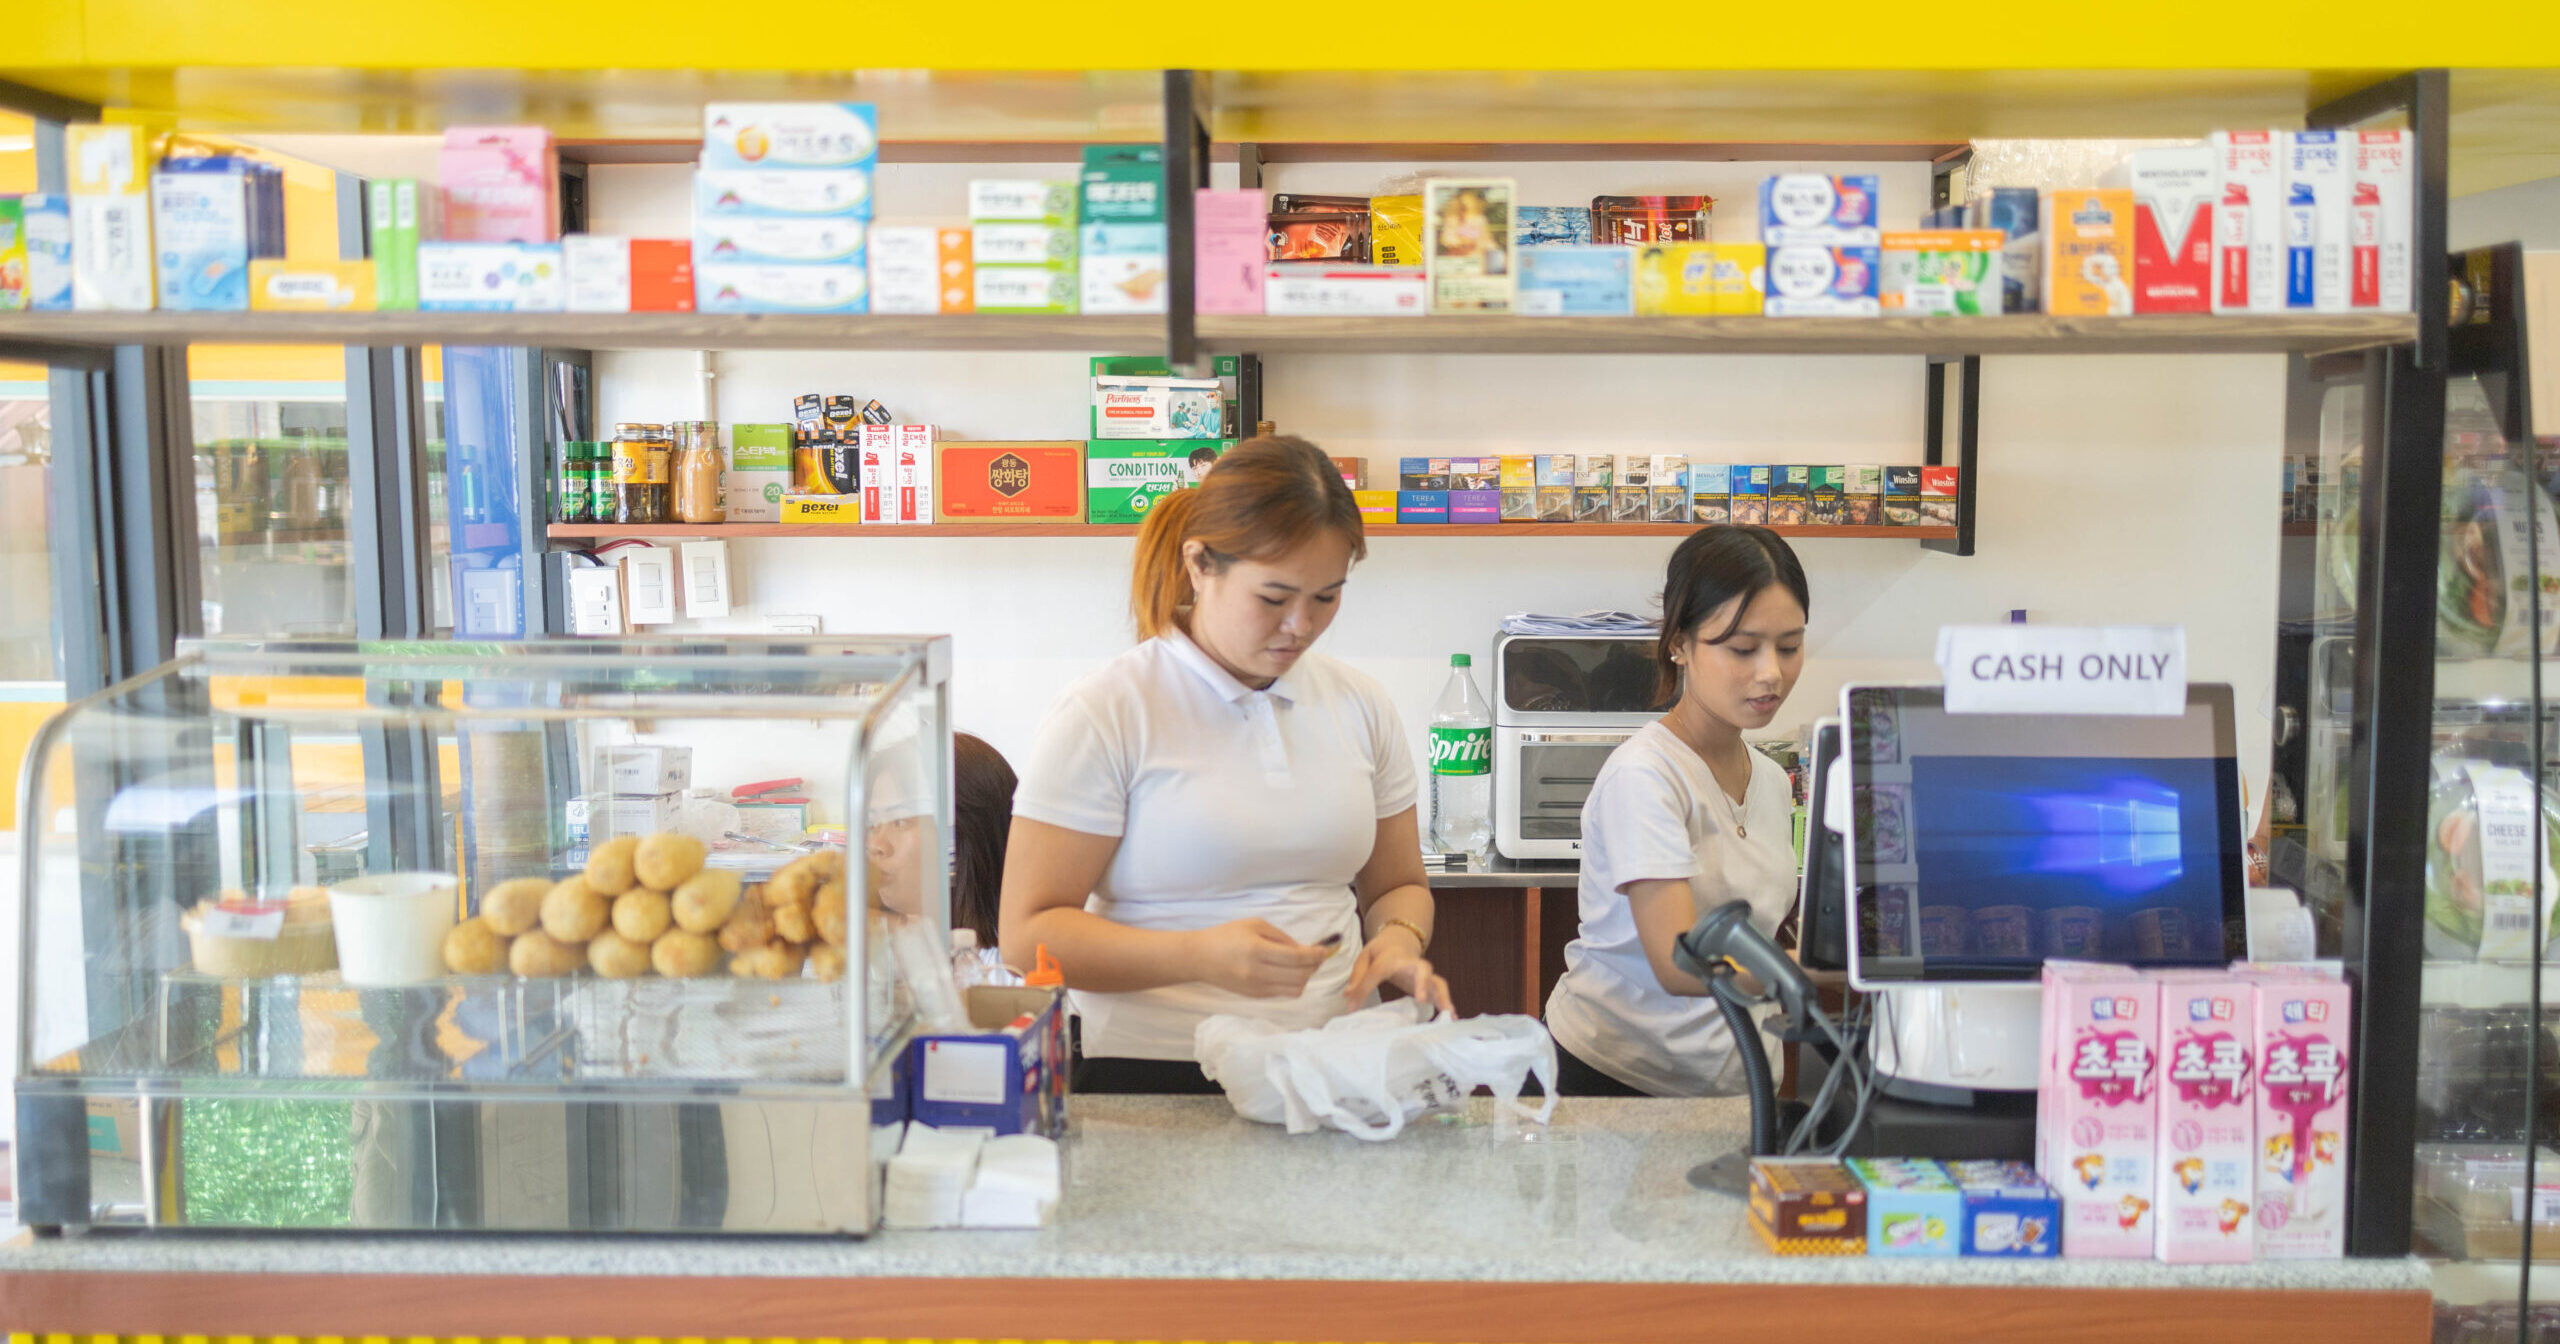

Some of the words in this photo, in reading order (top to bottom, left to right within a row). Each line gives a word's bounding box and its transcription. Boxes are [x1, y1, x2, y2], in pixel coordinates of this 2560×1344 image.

[834, 447, 849, 479] exel
[1108, 463, 1178, 477] CONDITION
[1893, 474, 1918, 485] Winston
[1931, 478, 1956, 487] Winston
[766, 486, 780, 496] 20
[1411, 494, 1436, 502] TEREA
[801, 503, 840, 513] Bexel
[1971, 653, 2064, 681] CASH
[2079, 653, 2170, 681] ONLY
[1428, 732, 1491, 766] Sprite
[2487, 823, 2527, 837] CHEESE
[2073, 1039, 2150, 1097] 초콕
[2172, 1041, 2247, 1099] 초콕
[2263, 1044, 2339, 1102] 초콕
